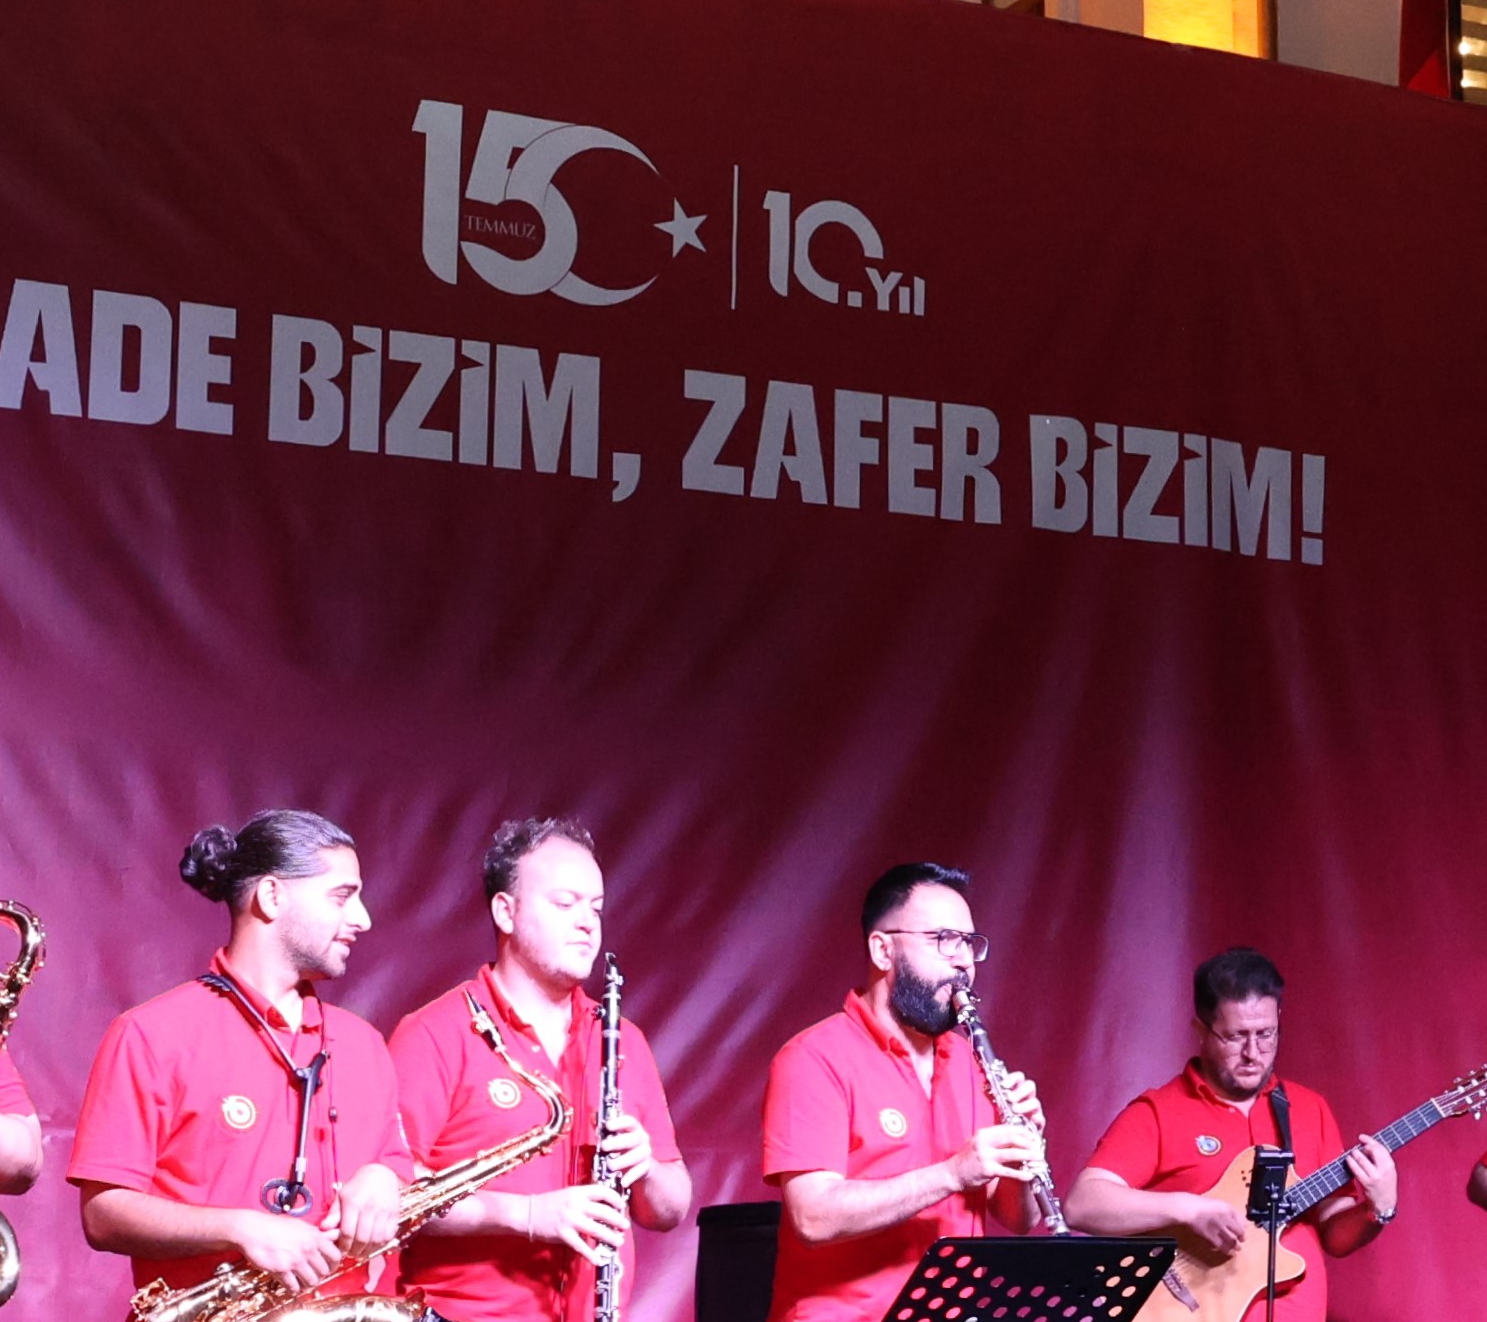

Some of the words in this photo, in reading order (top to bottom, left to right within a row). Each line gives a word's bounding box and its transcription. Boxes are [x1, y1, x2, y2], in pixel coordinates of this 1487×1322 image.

[464, 214, 537, 241] TEMMUZ
[682, 368, 1003, 525] ZAFER
[1029, 413, 1326, 566] BİZİM!
